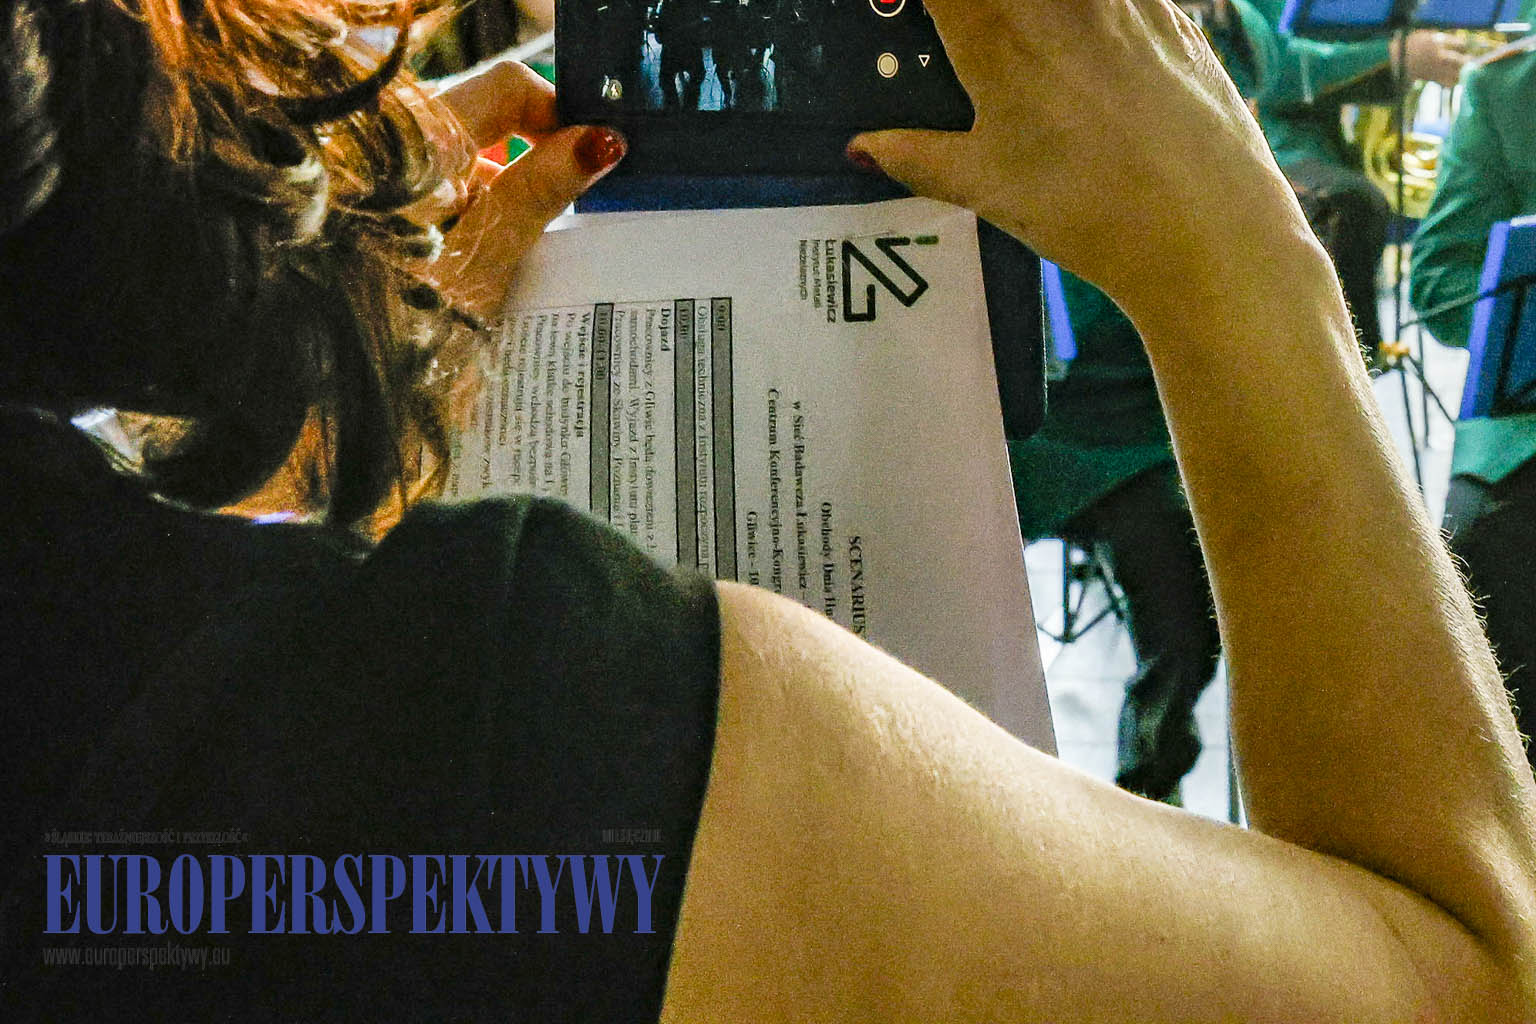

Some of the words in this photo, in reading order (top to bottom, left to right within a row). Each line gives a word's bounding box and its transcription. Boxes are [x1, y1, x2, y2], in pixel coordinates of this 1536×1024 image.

[813, 278, 822, 309] Metali
[825, 239, 838, 324] Łukasiewicz
[576, 312, 590, 361] Wejście
[641, 309, 657, 376] Pracownicy
[658, 307, 672, 352] Dojazd
[562, 378, 572, 393] do
[573, 370, 586, 439] rejestracja
[644, 390, 656, 430] Gliwic
[697, 358, 709, 422] techniczna
[792, 400, 801, 410] w
[625, 398, 639, 443] Wyjazd
[768, 388, 780, 446] Centrum
[793, 415, 805, 442] Sieć
[793, 444, 806, 508] Badawcza
[697, 491, 710, 559] rozpoczyna
[746, 511, 759, 559] Gliwice
[795, 512, 809, 590] Łukasiewicz
[820, 502, 833, 561] Obchody
[823, 563, 835, 593] Dnia
[849, 536, 867, 640] SCENARIUS
